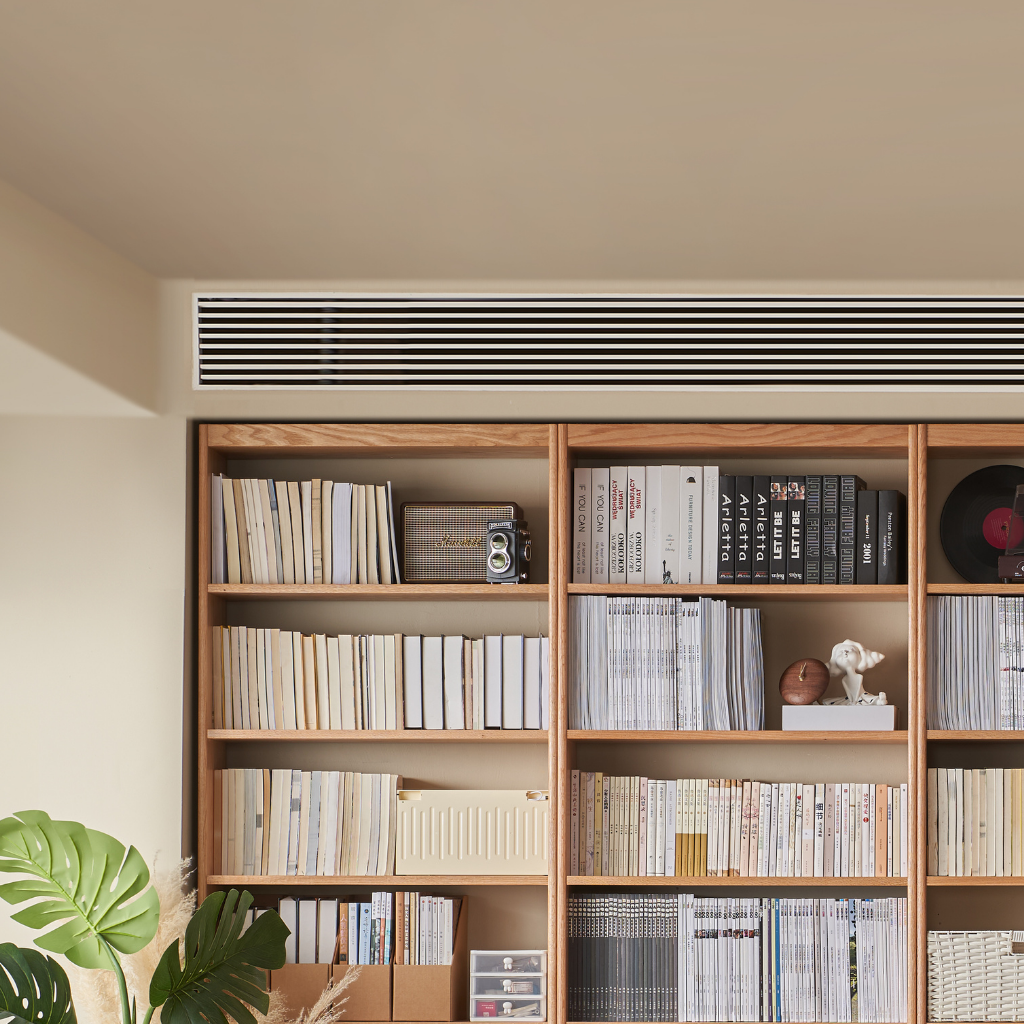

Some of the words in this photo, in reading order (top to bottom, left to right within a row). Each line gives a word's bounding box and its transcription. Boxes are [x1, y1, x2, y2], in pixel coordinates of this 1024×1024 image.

[807, 478, 820, 514] LOVING
[824, 478, 836, 514] LOVING
[842, 478, 854, 501] MAN
[722, 494, 732, 561] Arletta
[739, 494, 750, 561] Arletta
[757, 494, 767, 561] Arletta
[774, 511, 782, 525] BE
[791, 511, 800, 525] BE
[791, 527, 800, 537] IT
[841, 506, 854, 544] FAMILY
[774, 528, 782, 538] IT
[807, 518, 820, 557] FAMILY
[824, 518, 836, 557] FAMILY
[774, 540, 782, 559] LET
[791, 539, 800, 558] LET
[863, 543, 871, 564] 2001
